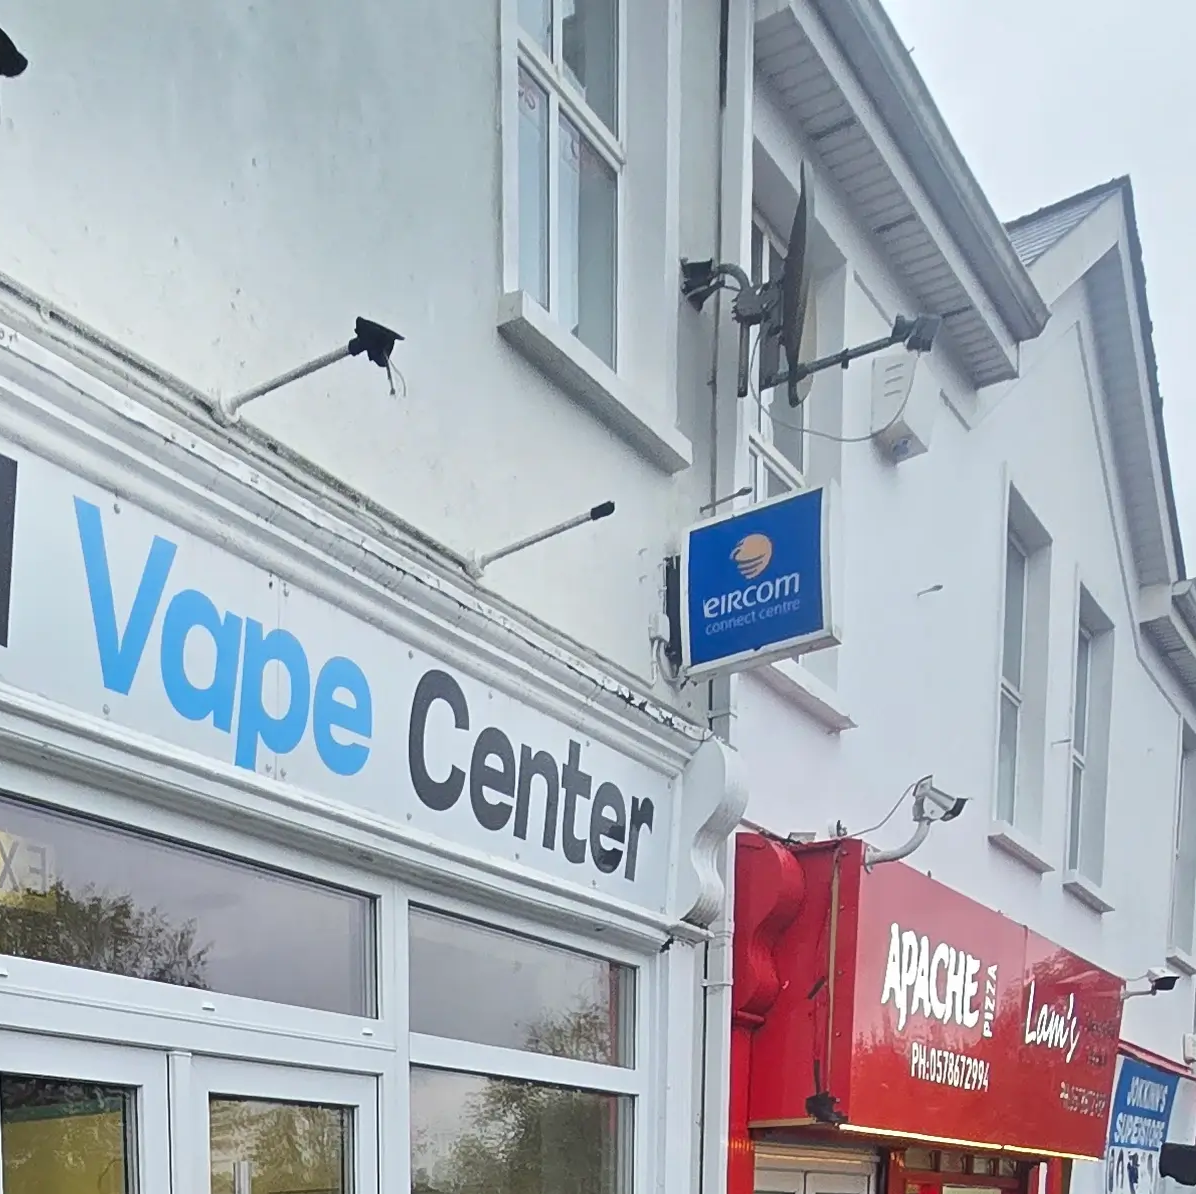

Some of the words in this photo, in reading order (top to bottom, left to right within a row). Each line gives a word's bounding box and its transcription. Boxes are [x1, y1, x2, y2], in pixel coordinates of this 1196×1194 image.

[705, 610, 756, 636] connect
[758, 599, 800, 620] centre
[73, 495, 372, 775] Vape
[408, 669, 654, 881] Center
[881, 922, 980, 1031] APACHE
[983, 965, 998, 1037] PIZZA
